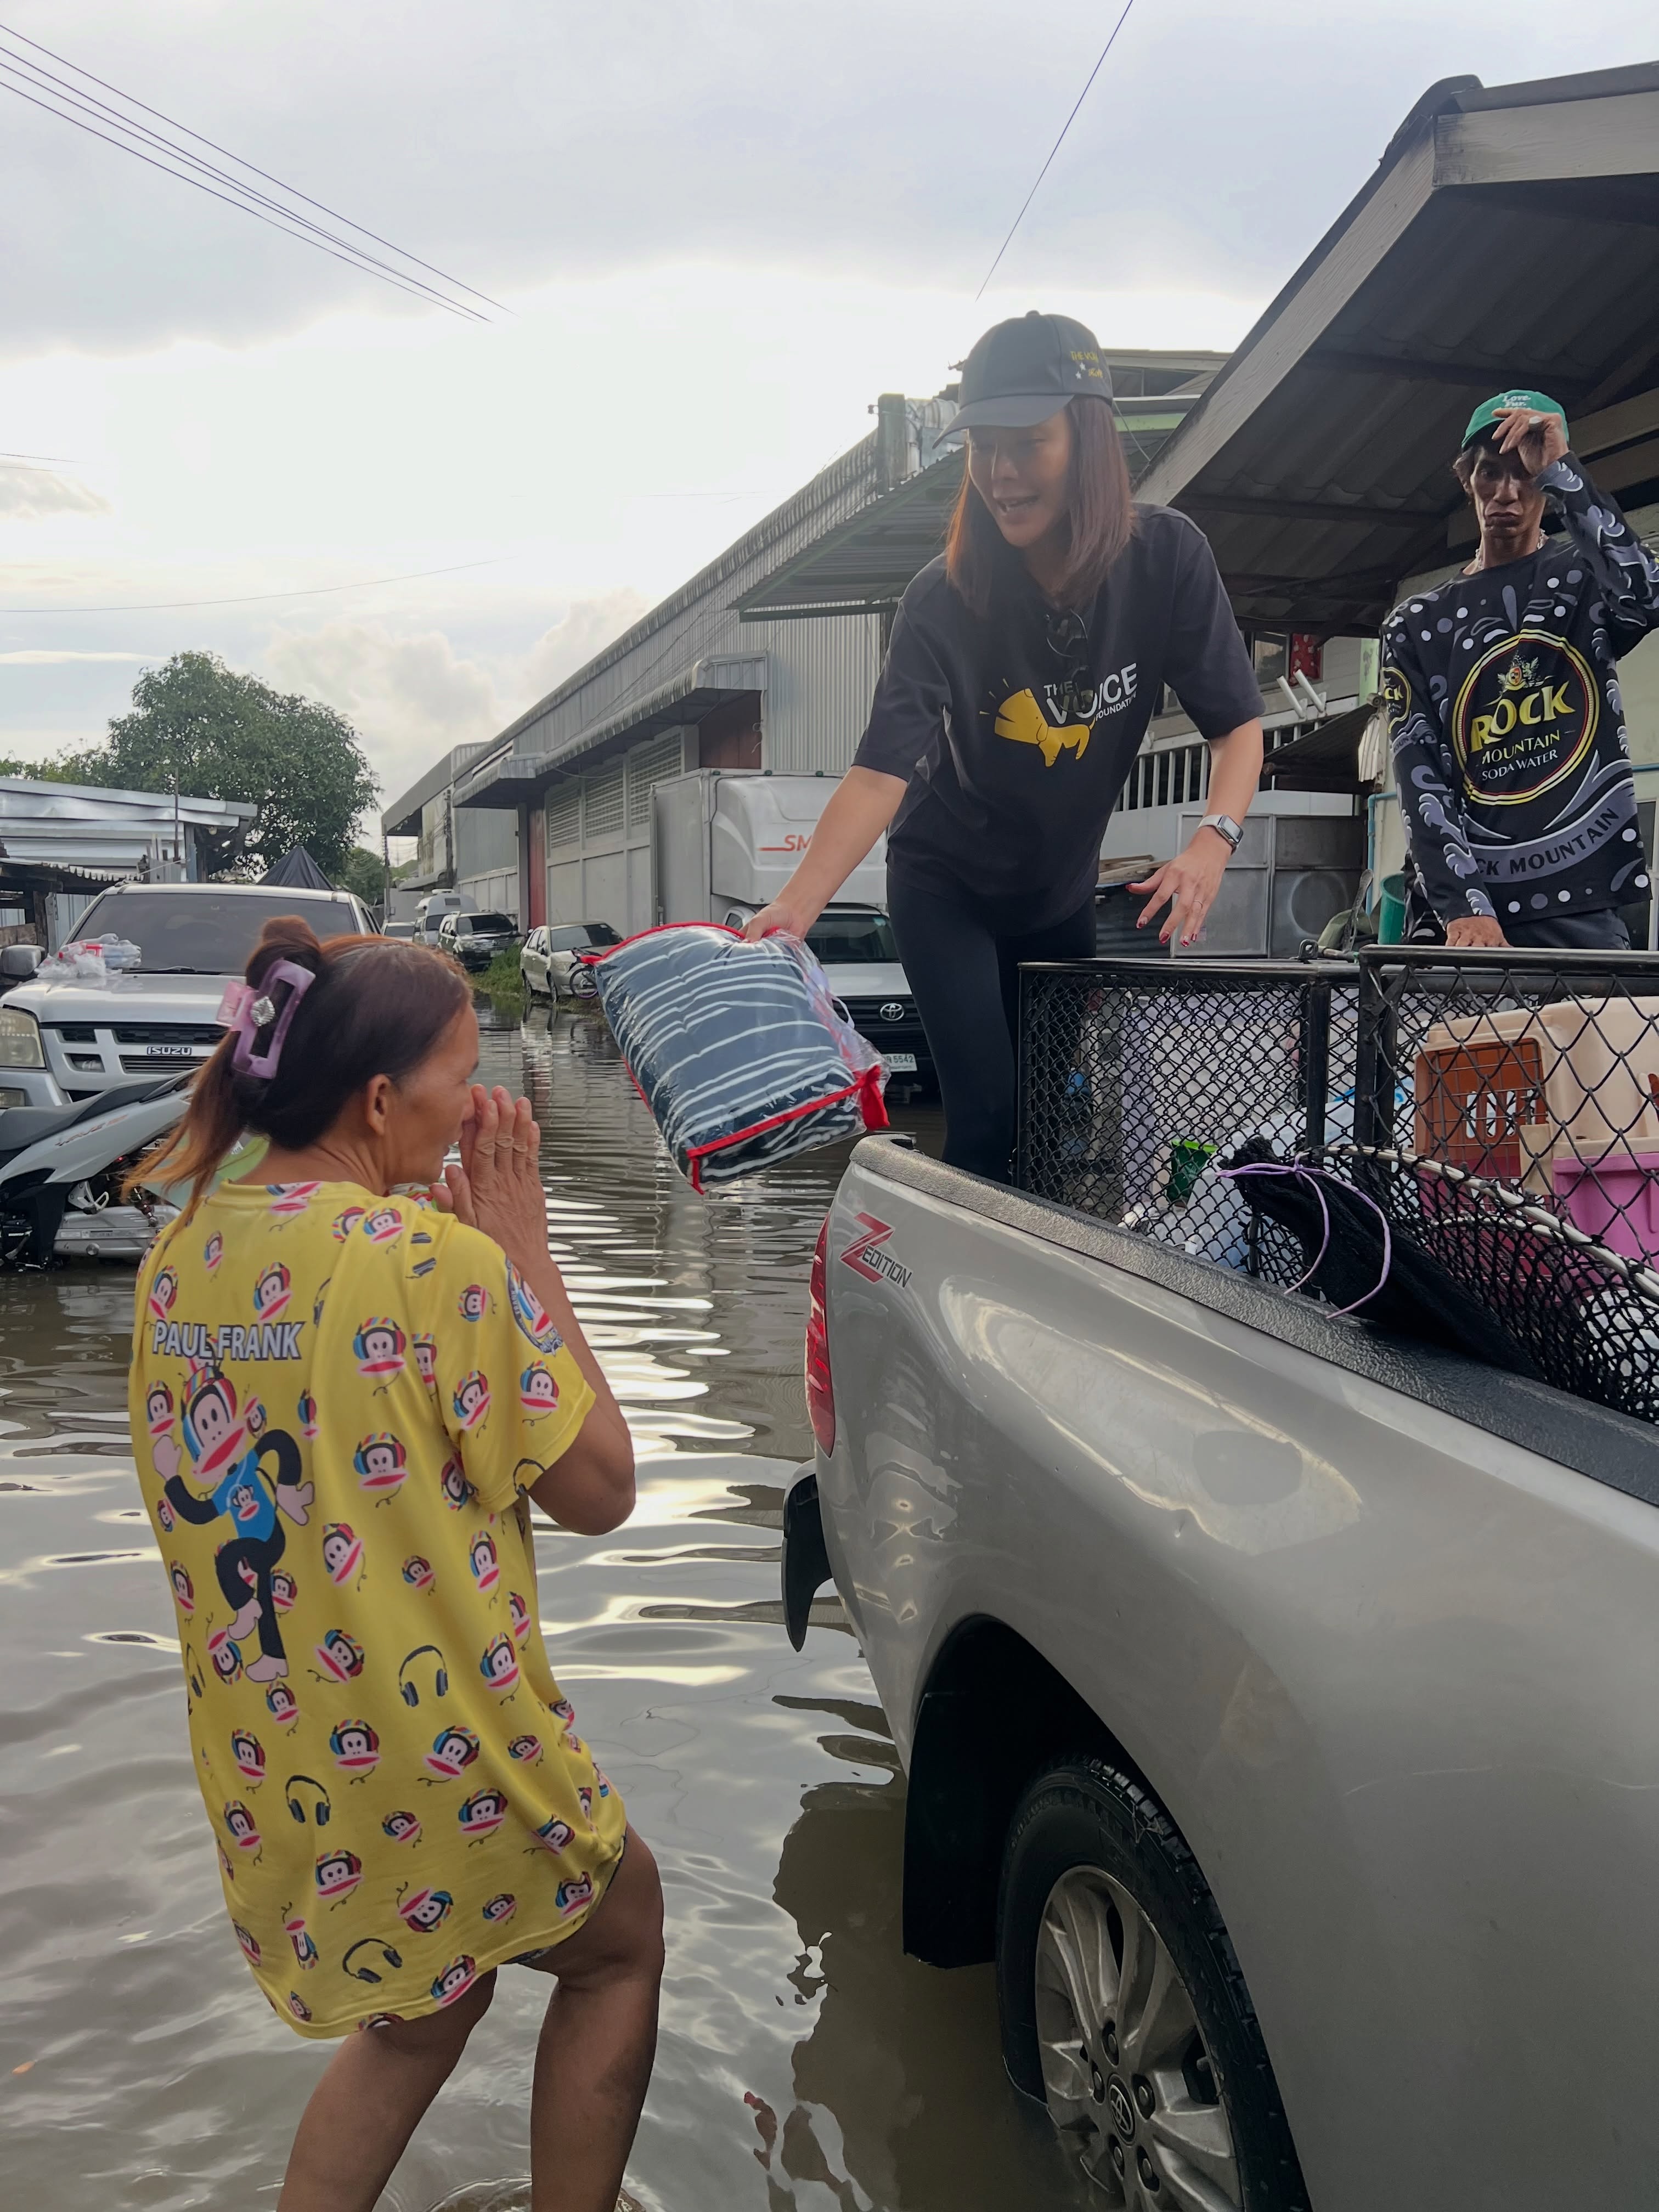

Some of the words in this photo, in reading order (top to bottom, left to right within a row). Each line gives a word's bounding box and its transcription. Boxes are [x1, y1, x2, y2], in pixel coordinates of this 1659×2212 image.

[1044, 681, 1074, 697] THE
[1385, 686, 1404, 701] CK
[1470, 680, 1576, 753] ROCK
[1482, 763, 1514, 781] SODA
[1516, 749, 1558, 769] WATER
[1476, 858, 1499, 876] CK
[1510, 808, 1619, 874] MOUNTAIN
[147, 1046, 191, 1056] ISUZU
[862, 1245, 912, 1288] EDITION
[153, 1319, 213, 1359] PAUL
[218, 1321, 306, 1361] FRANK
